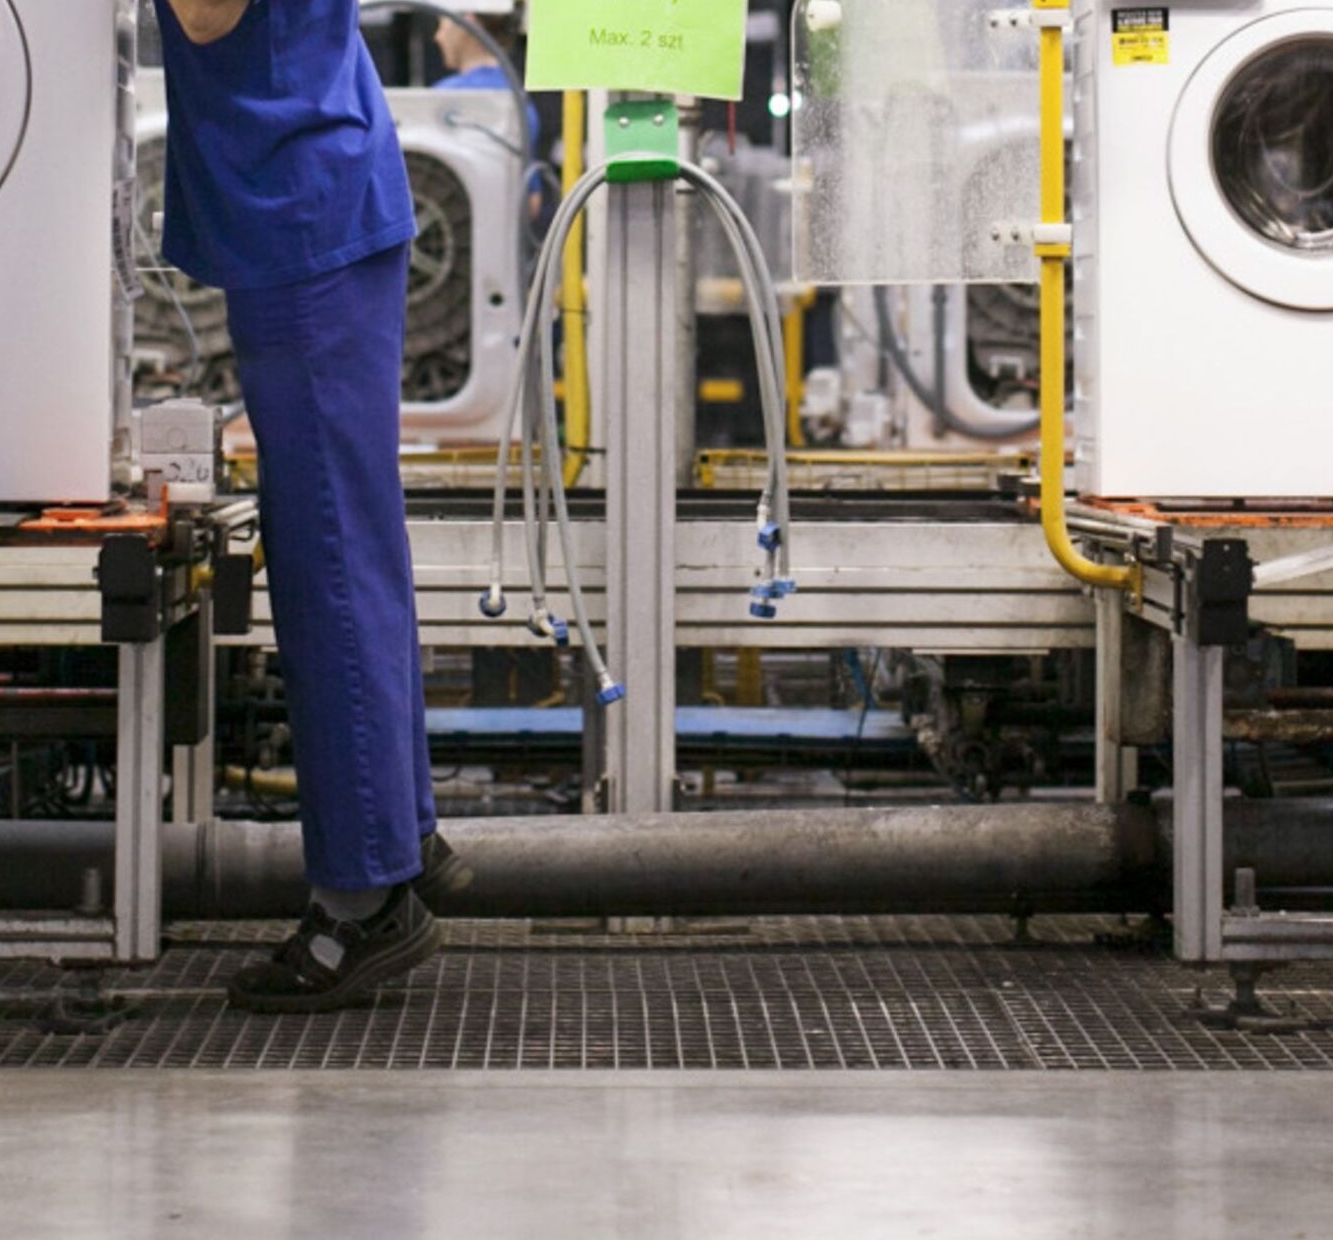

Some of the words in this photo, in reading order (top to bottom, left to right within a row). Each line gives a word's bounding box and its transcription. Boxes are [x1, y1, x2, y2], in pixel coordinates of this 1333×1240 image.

[589, 28, 634, 47] Max.
[640, 29, 652, 47] 2
[658, 33, 685, 51] szt
